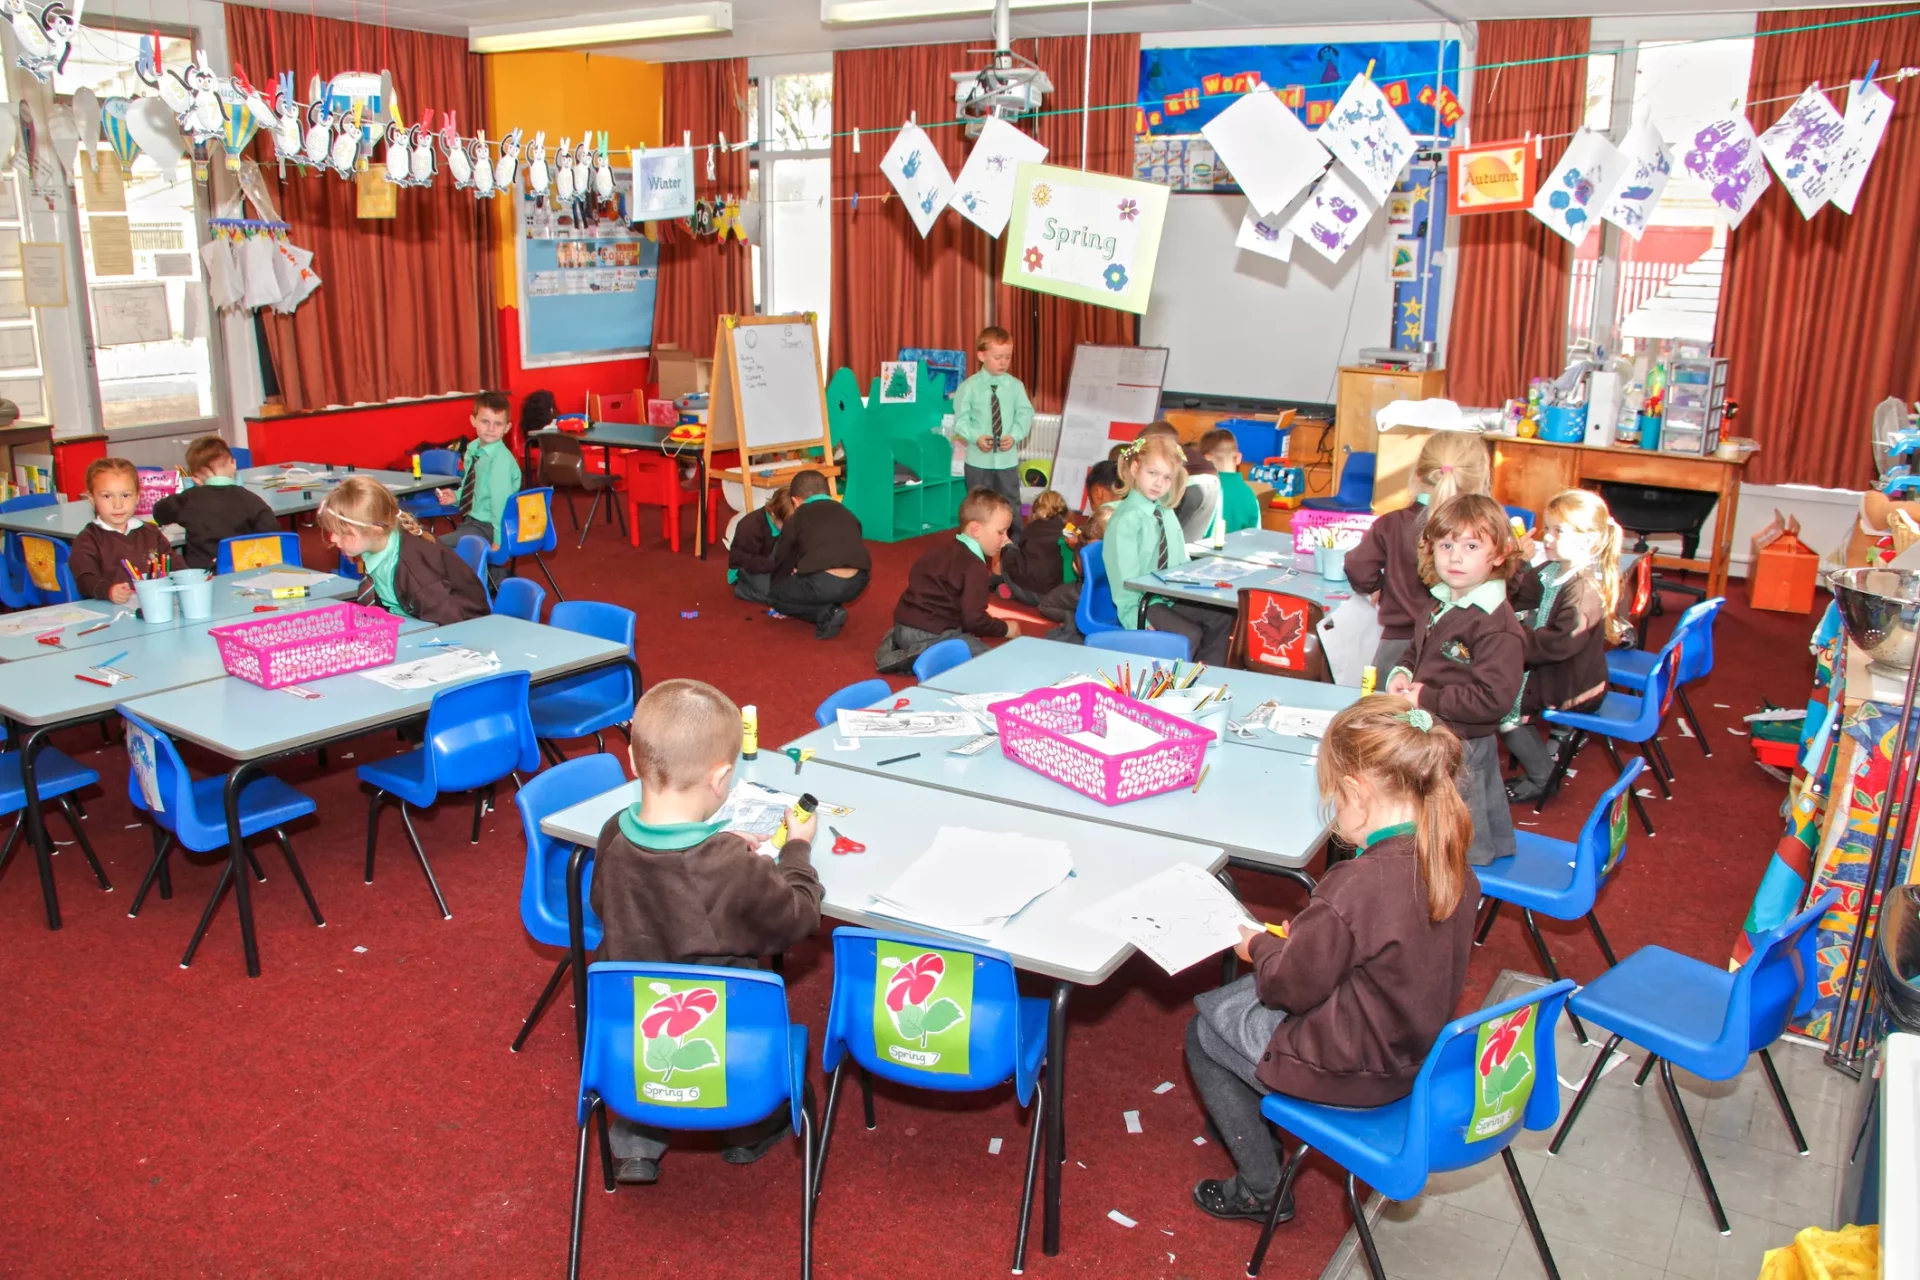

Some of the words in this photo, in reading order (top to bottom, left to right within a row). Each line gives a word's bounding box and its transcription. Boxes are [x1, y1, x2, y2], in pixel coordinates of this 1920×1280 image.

[1168, 90, 1200, 112] all
[1310, 101, 1333, 124] pl
[648, 176, 682, 190] Winter
[1464, 172, 1519, 187] Autumn
[697, 209, 709, 225] 16
[1042, 217, 1117, 261] Spring
[890, 1046, 926, 1065] Spring
[931, 1052, 940, 1063] 7
[644, 1083, 684, 1101] Spring
[689, 1086, 699, 1098] 6
[1476, 1115, 1505, 1134] Spring
